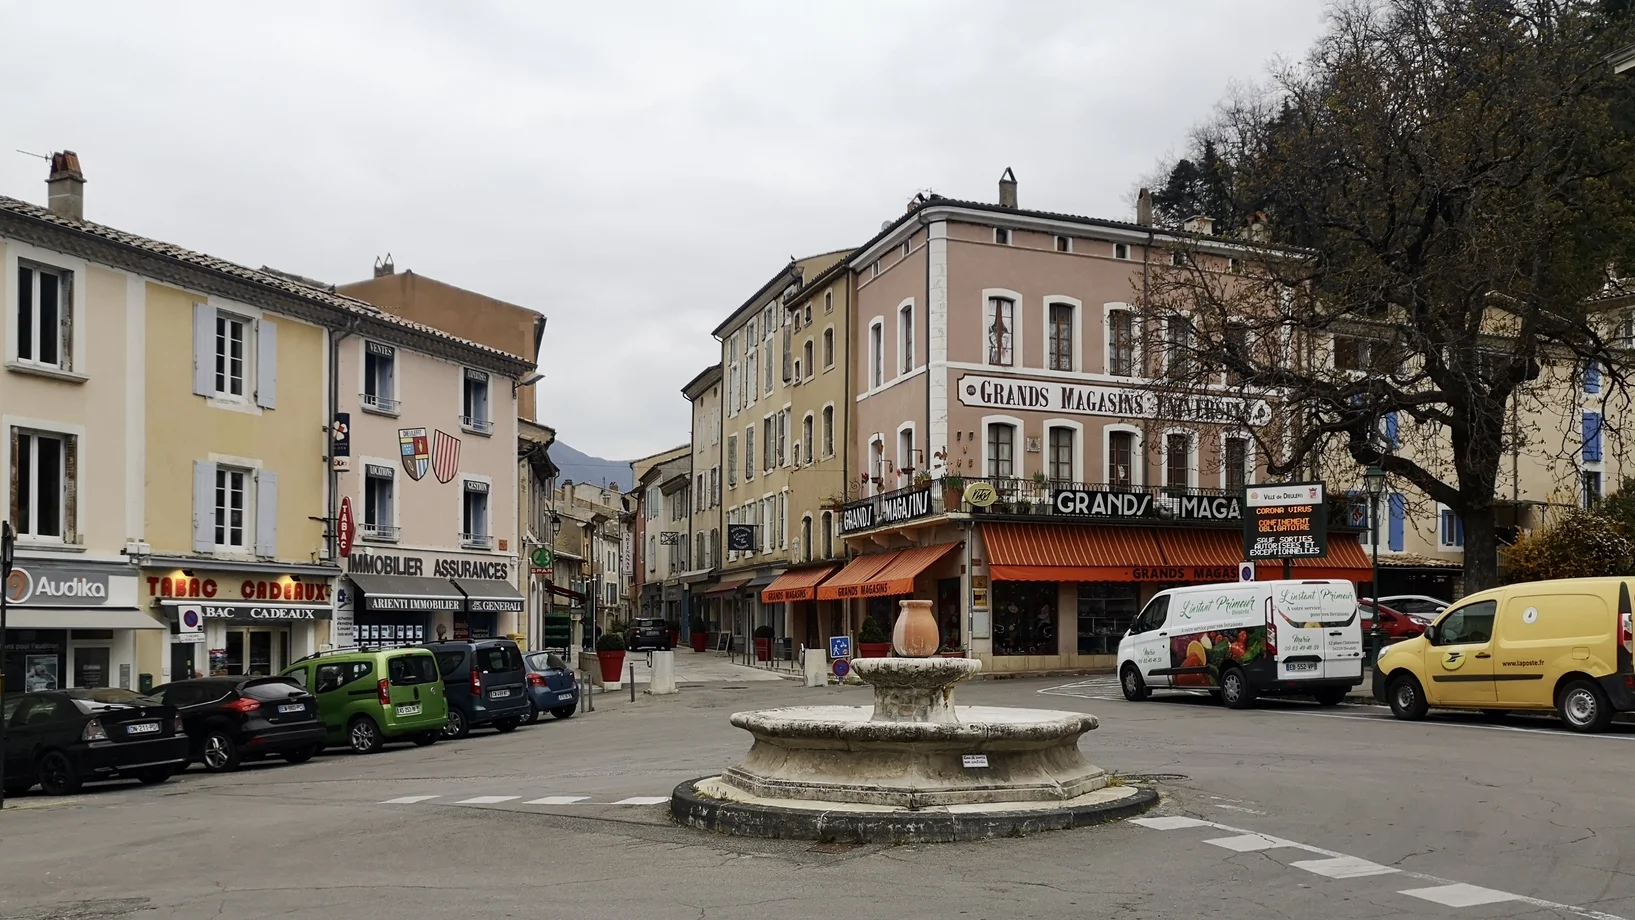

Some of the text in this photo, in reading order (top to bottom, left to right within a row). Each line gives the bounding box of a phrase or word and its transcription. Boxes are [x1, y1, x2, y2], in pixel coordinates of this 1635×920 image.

[370, 342, 392, 356] VENTES
[980, 380, 1049, 408] GRANDS
[1061, 386, 1144, 414] MAGASINS
[370, 466, 392, 477] LOCATIONS
[467, 480, 488, 492] GESTION
[844, 490, 929, 530] GRANDS MAGASINS
[1057, 492, 1242, 519] GRANDS MAGA
[1258, 518, 1310, 526] CONFINEMENT
[1258, 524, 1310, 532] OBLIGATOIRE
[1250, 547, 1320, 556] EXCEPTIONNELLES
[348, 553, 508, 580] IMMOBILIER ASSURANCES
[1132, 568, 1239, 579] GRANDS MAGAS
[35, 576, 106, 598] Audika
[146, 576, 326, 600] TABAC CADEAUX
[838, 583, 888, 596] GRANDS MAGASINS
[768, 590, 806, 600] GRANDS MAGASINS
[1320, 588, 1353, 602] Primeur
[372, 598, 460, 610] ARIENTI IMMOBILIER
[482, 601, 522, 611] GENERALI
[1216, 596, 1255, 613] Primeur
[201, 607, 315, 619] BAC CADEAUX
